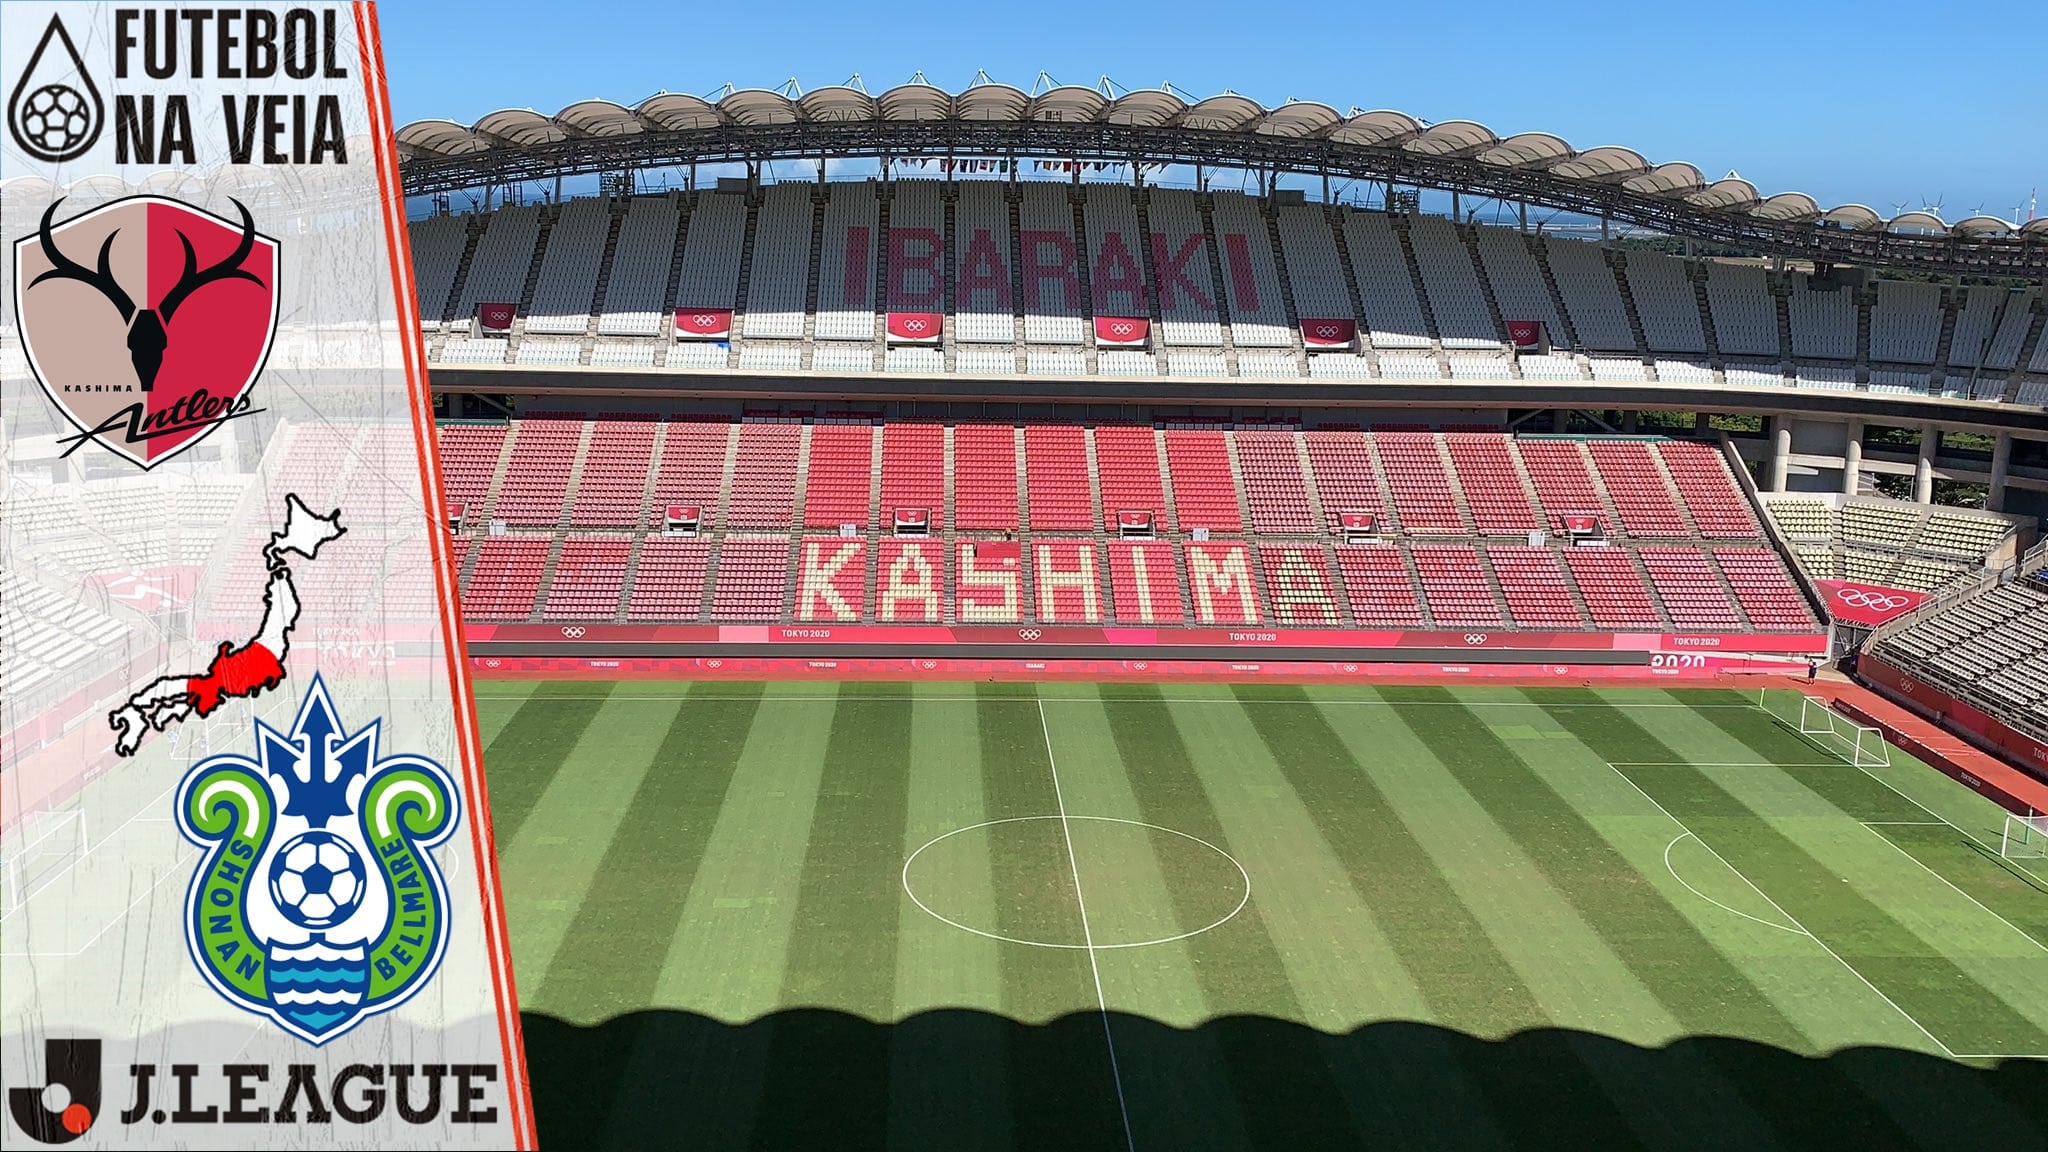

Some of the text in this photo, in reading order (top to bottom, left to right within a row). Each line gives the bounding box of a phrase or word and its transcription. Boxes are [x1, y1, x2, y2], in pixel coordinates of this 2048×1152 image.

[843, 226, 1260, 312] IBARAKI
[798, 541, 1341, 625] KASHIMA
[782, 629, 830, 638] TOKYO 2020
[1229, 632, 1277, 642] TOKYO 2020
[1674, 637, 1720, 646] TOKYO 2020
